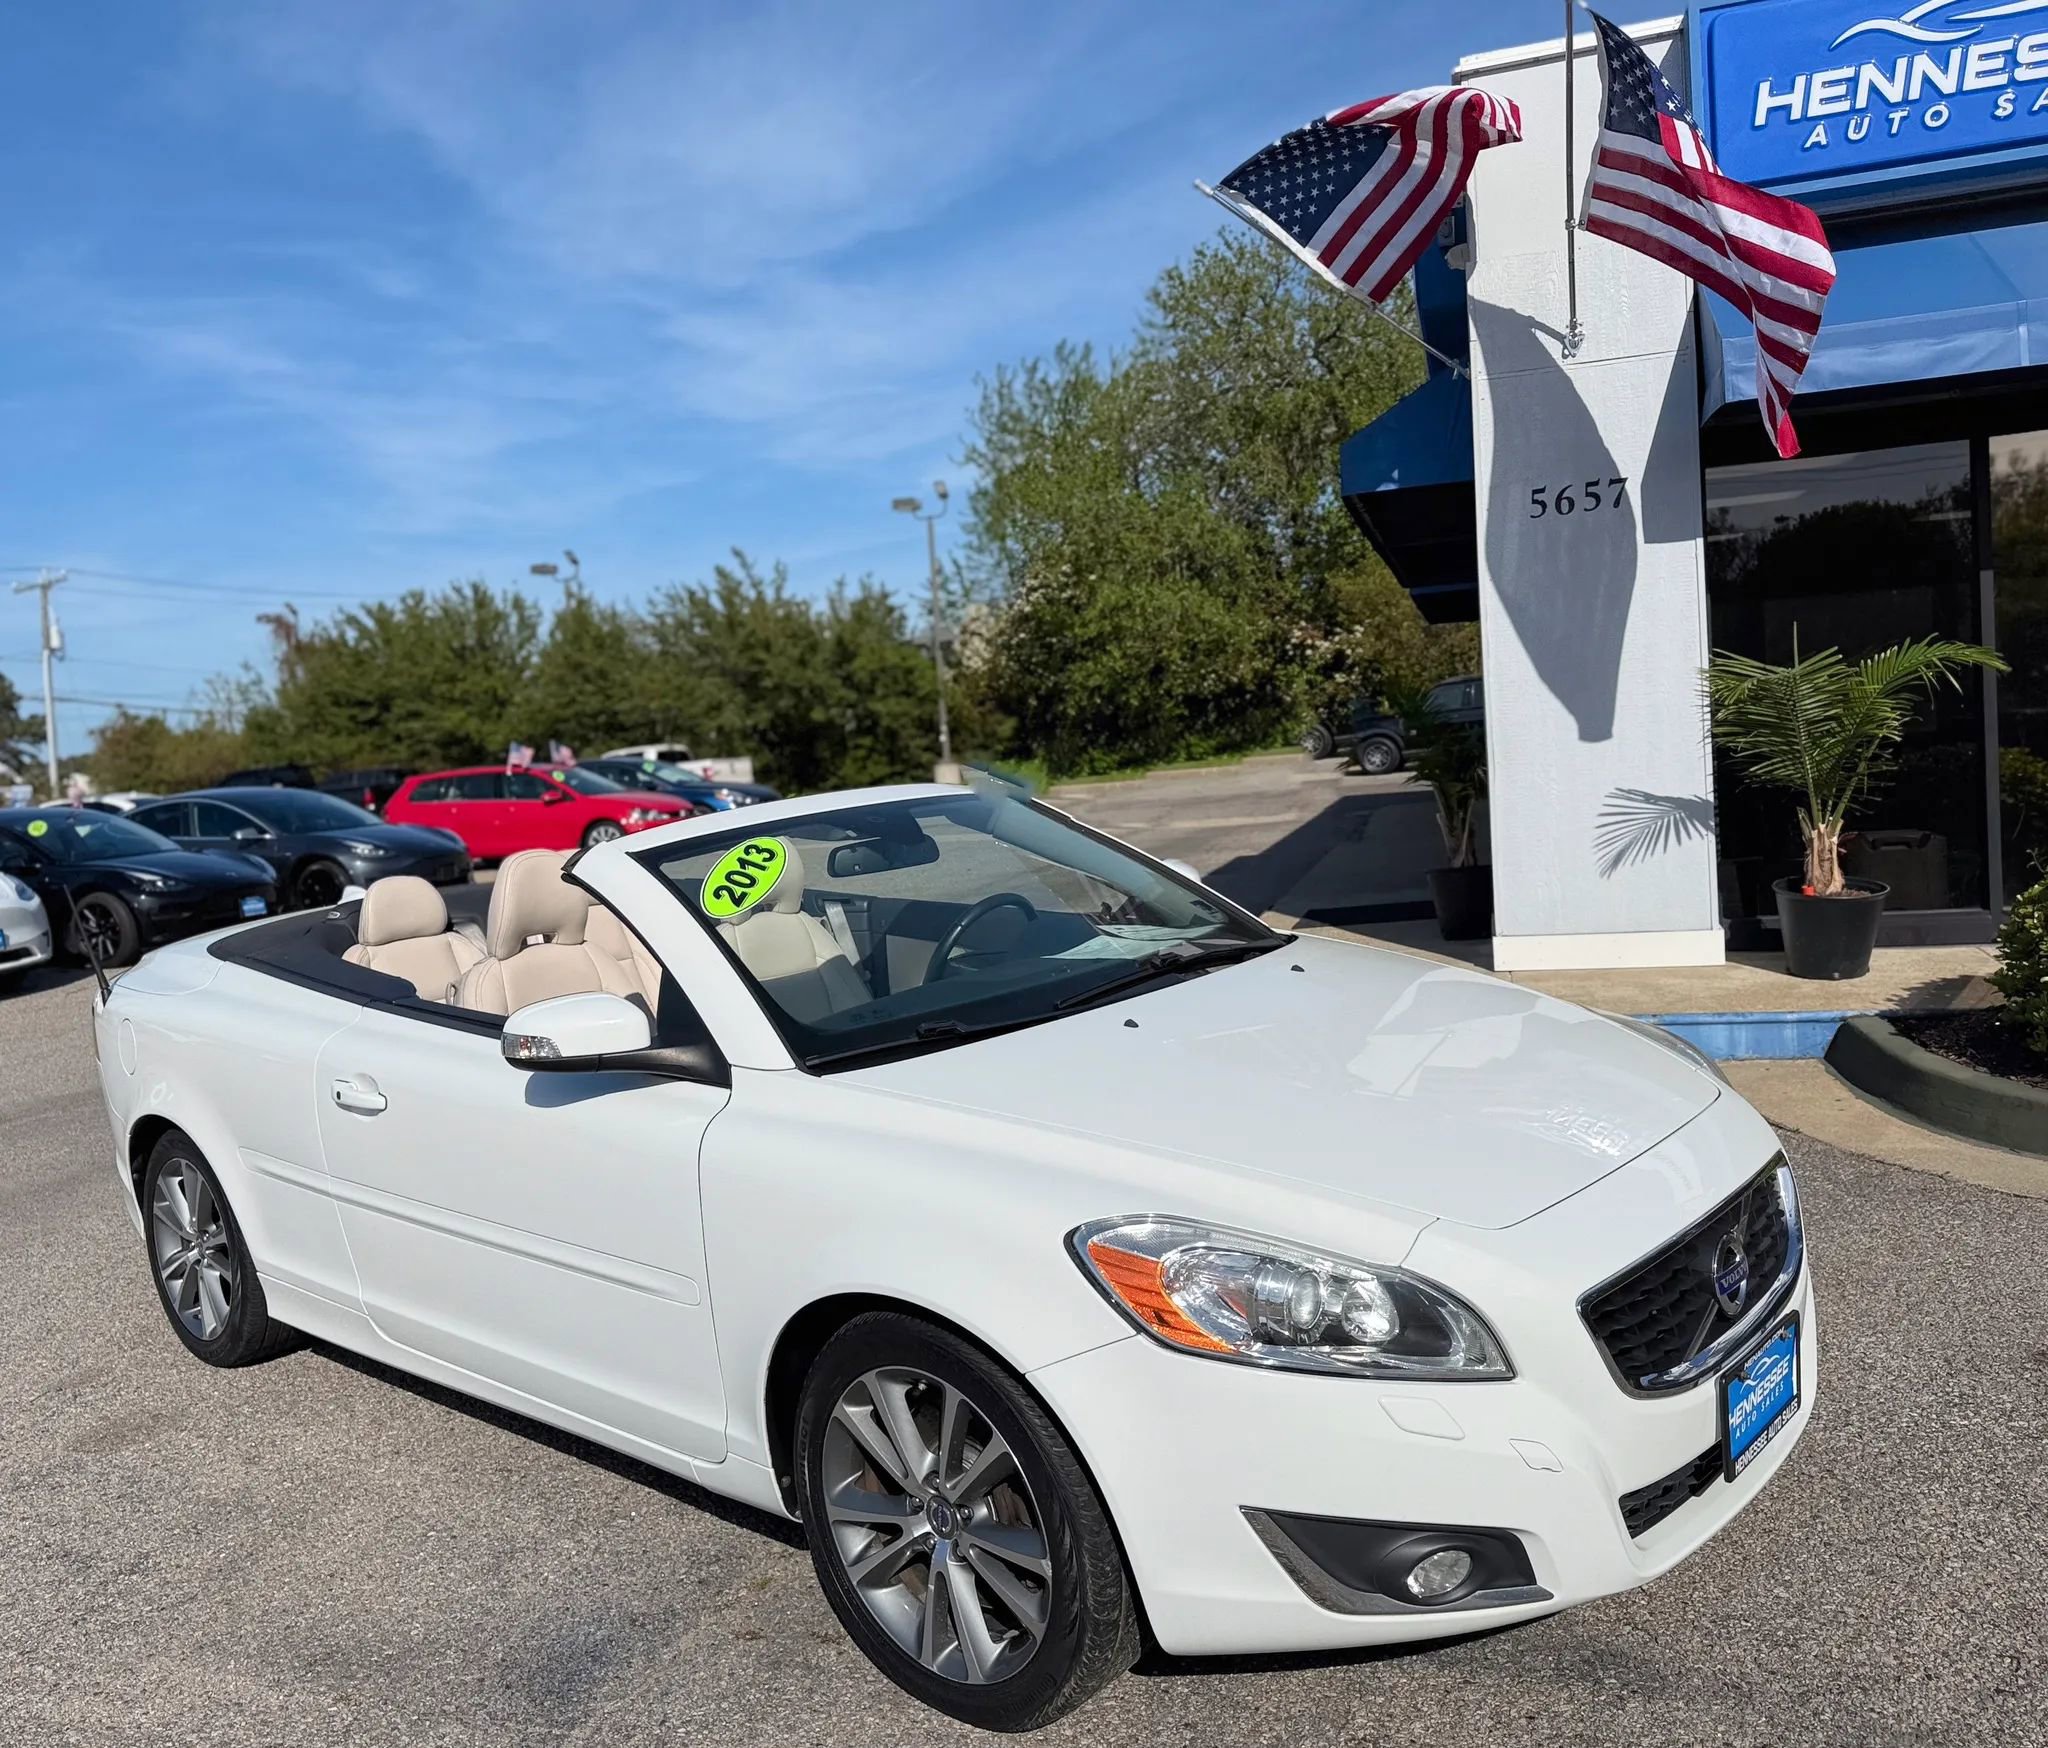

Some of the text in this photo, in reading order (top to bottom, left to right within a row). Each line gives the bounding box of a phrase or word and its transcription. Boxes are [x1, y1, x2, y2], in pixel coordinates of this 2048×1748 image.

[1753, 32, 2048, 127] HENNES
[1803, 101, 1950, 149] AUTO
[1529, 476, 1629, 519] 5657
[712, 843, 778, 909] 2013
[1728, 1353, 1791, 1428] HENNESSEE
[1735, 1380, 1784, 1439] AUTO SALES
[1735, 1398, 1798, 1476] HENNESSEE AUTO SALES
